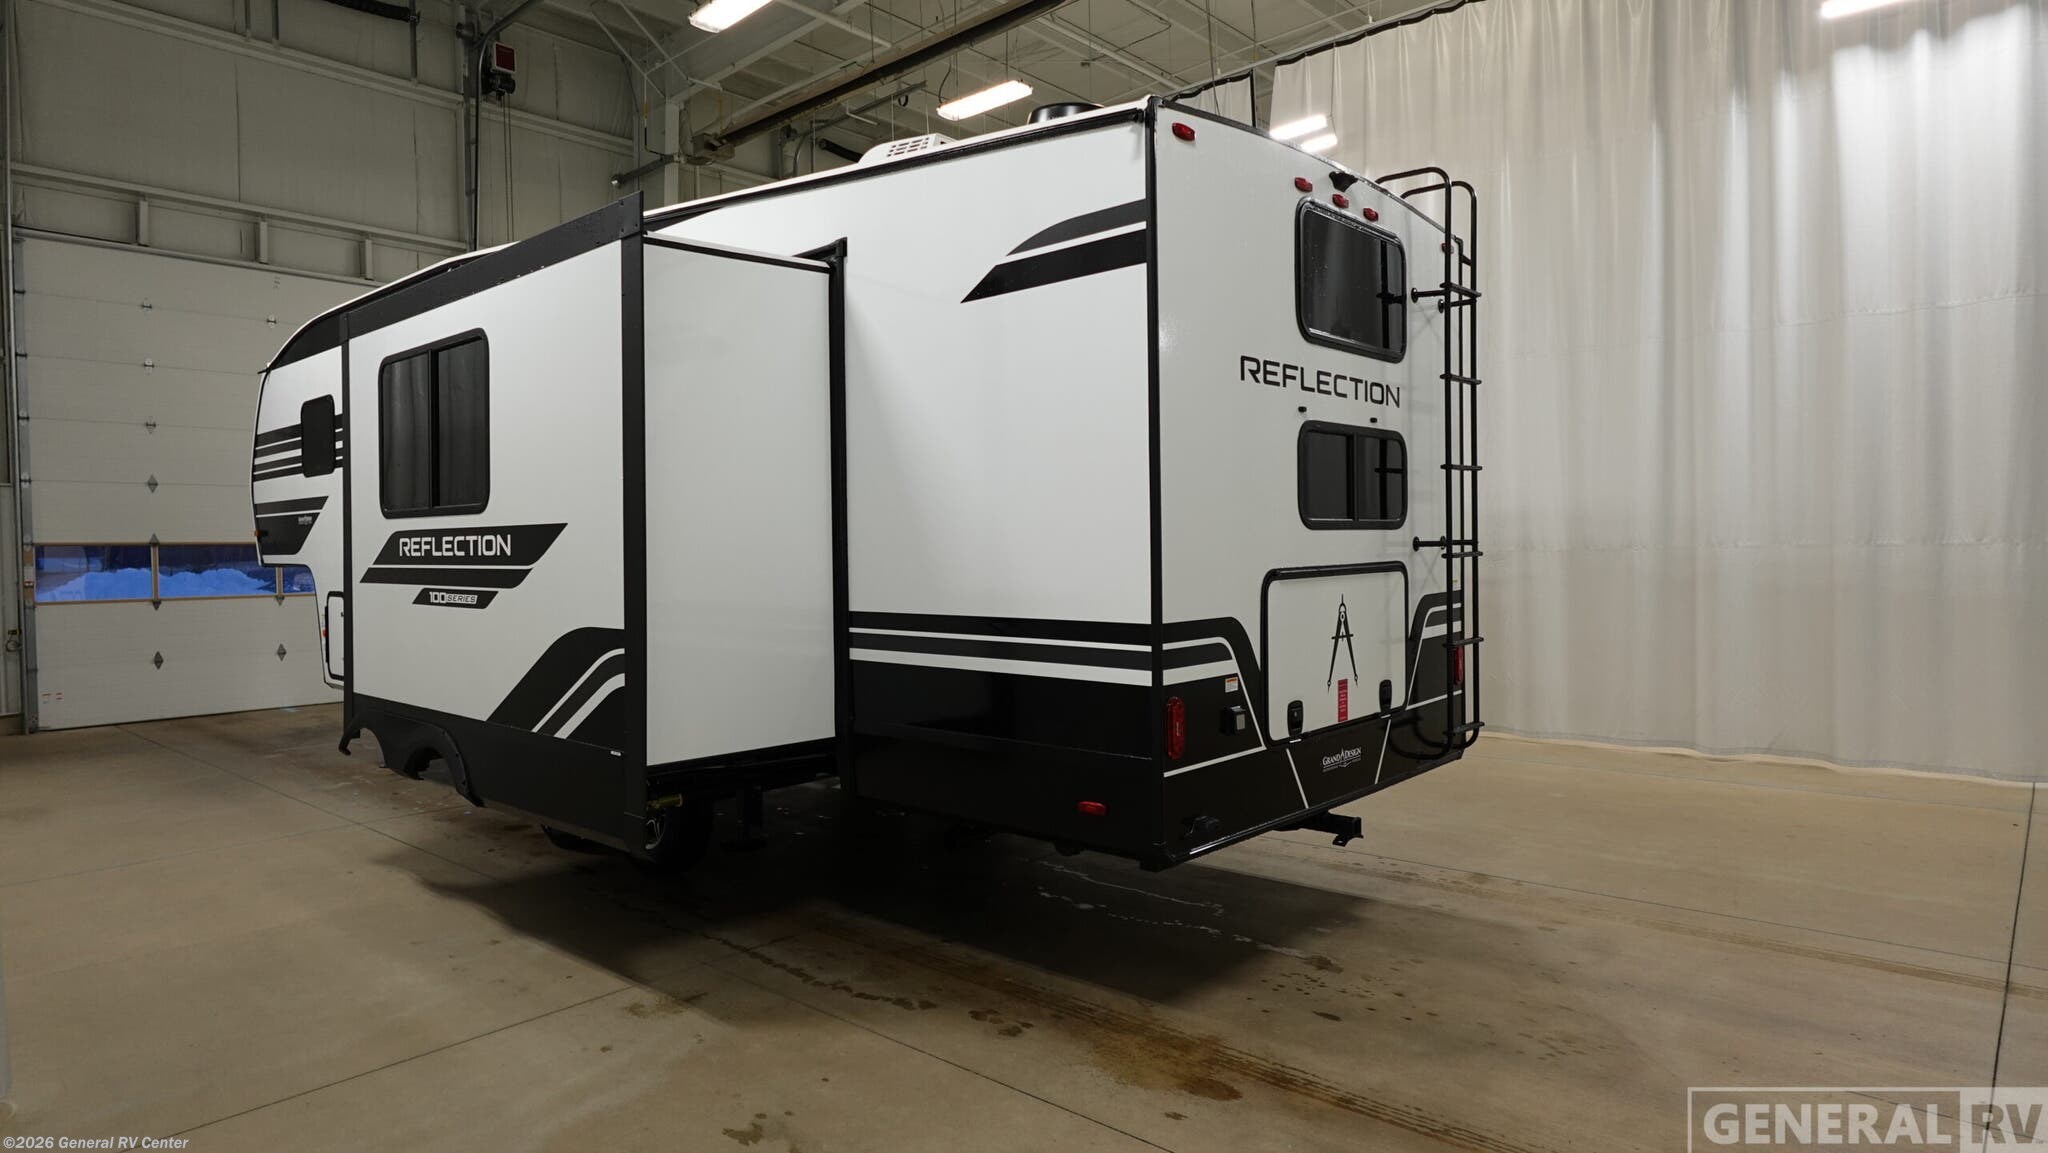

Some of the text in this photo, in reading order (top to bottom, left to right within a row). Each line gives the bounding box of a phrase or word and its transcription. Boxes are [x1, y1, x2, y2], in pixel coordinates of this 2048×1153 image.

[1240, 355, 1400, 409] REFLECTION
[399, 534, 512, 557] REFLECTION
[429, 591, 476, 604] 100 SERIES
